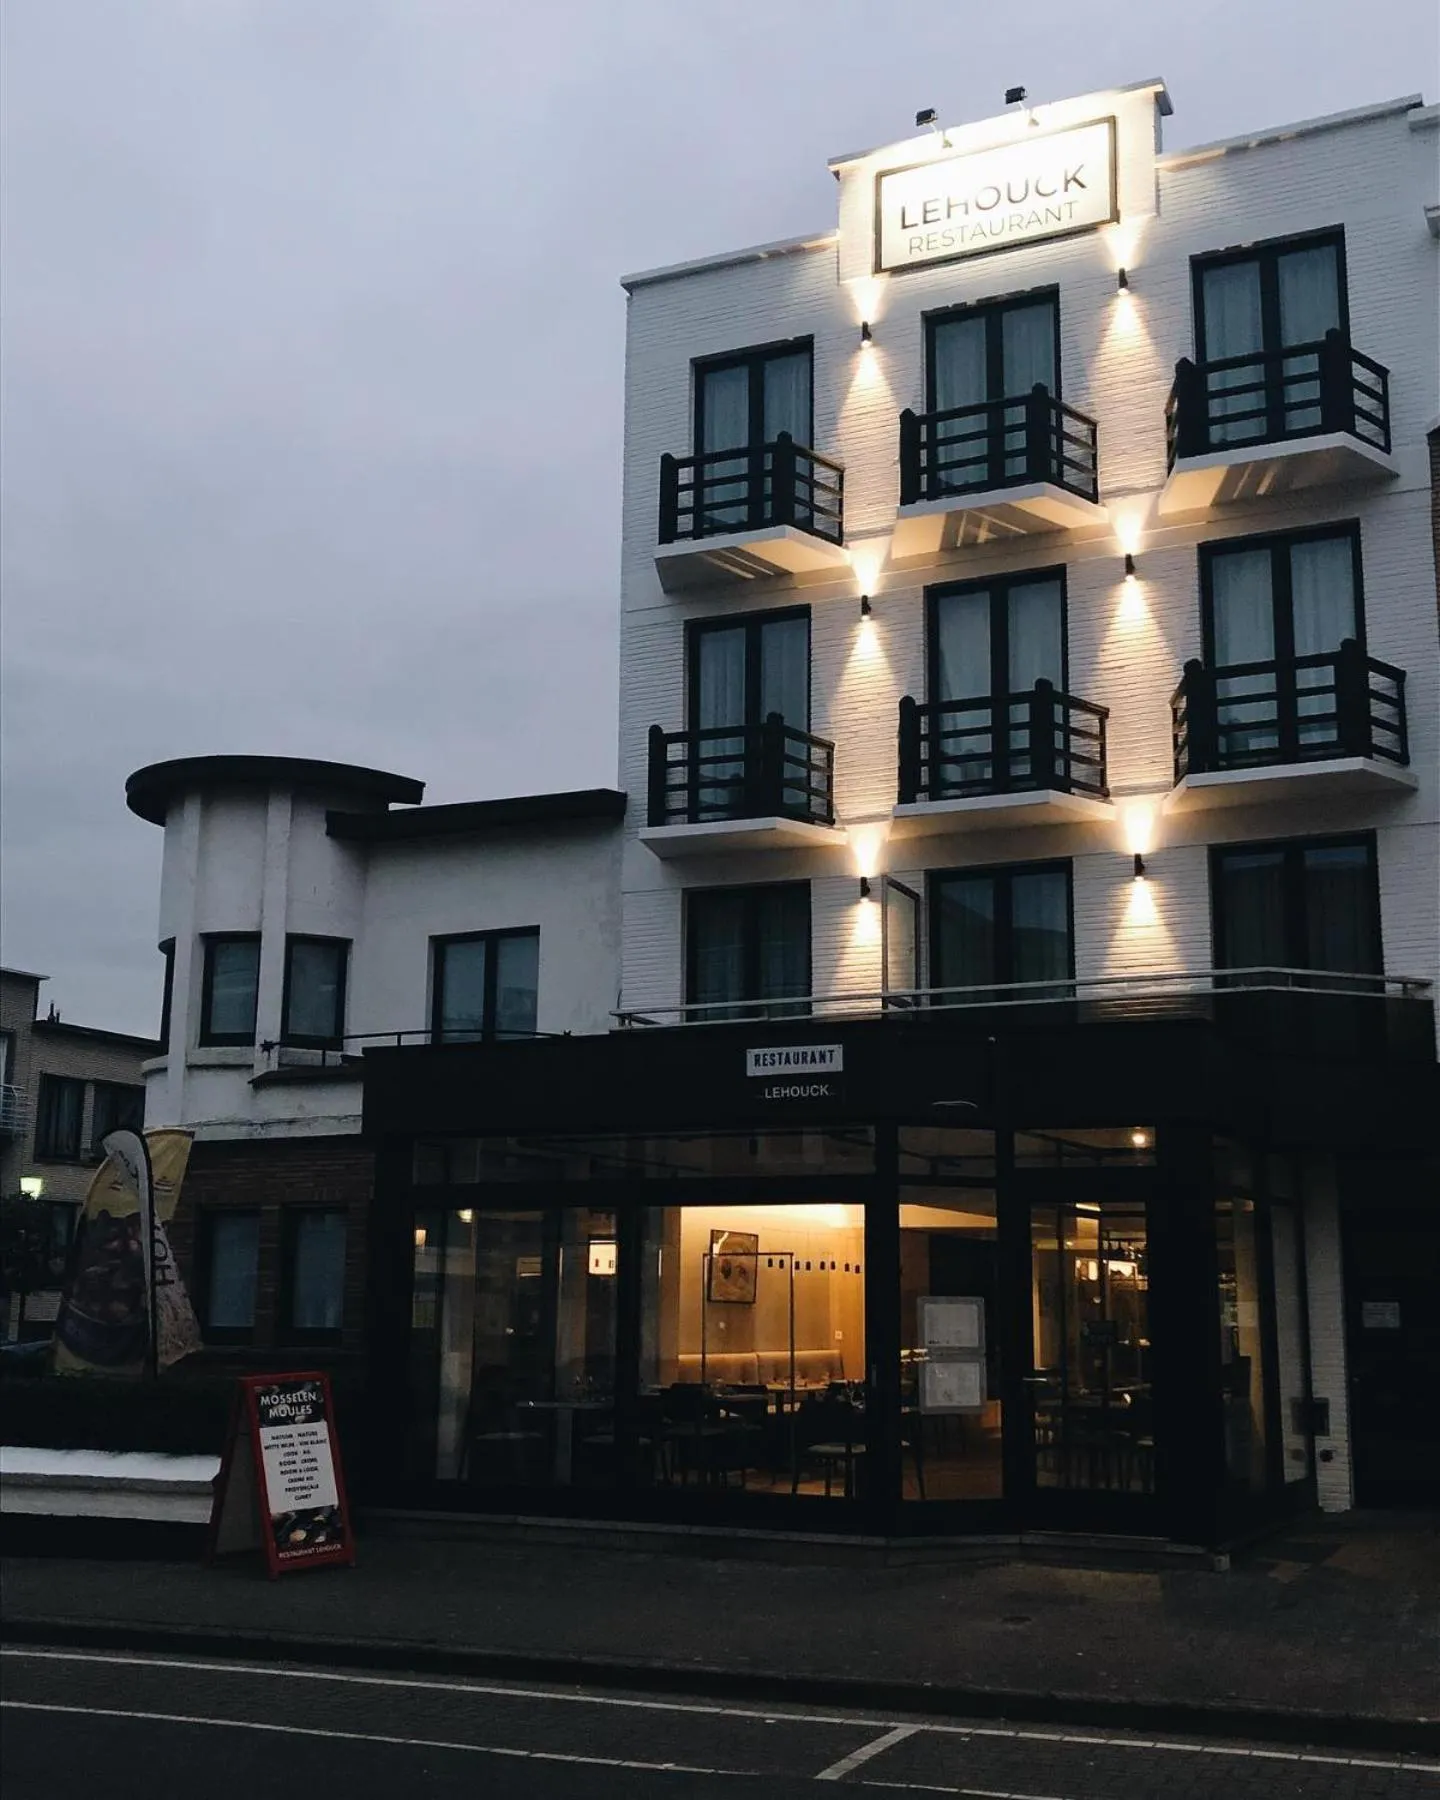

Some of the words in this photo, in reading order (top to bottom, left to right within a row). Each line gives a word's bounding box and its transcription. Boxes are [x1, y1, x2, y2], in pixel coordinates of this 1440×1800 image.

[901, 163, 1087, 230] LEHOUCK
[908, 199, 1079, 255] RESTAURANT
[754, 1050, 835, 1067] RESTAURANT
[764, 1084, 830, 1099] LEHOUCK
[260, 1391, 317, 1406] MOSSELEN
[269, 1404, 313, 1419] MOULES
